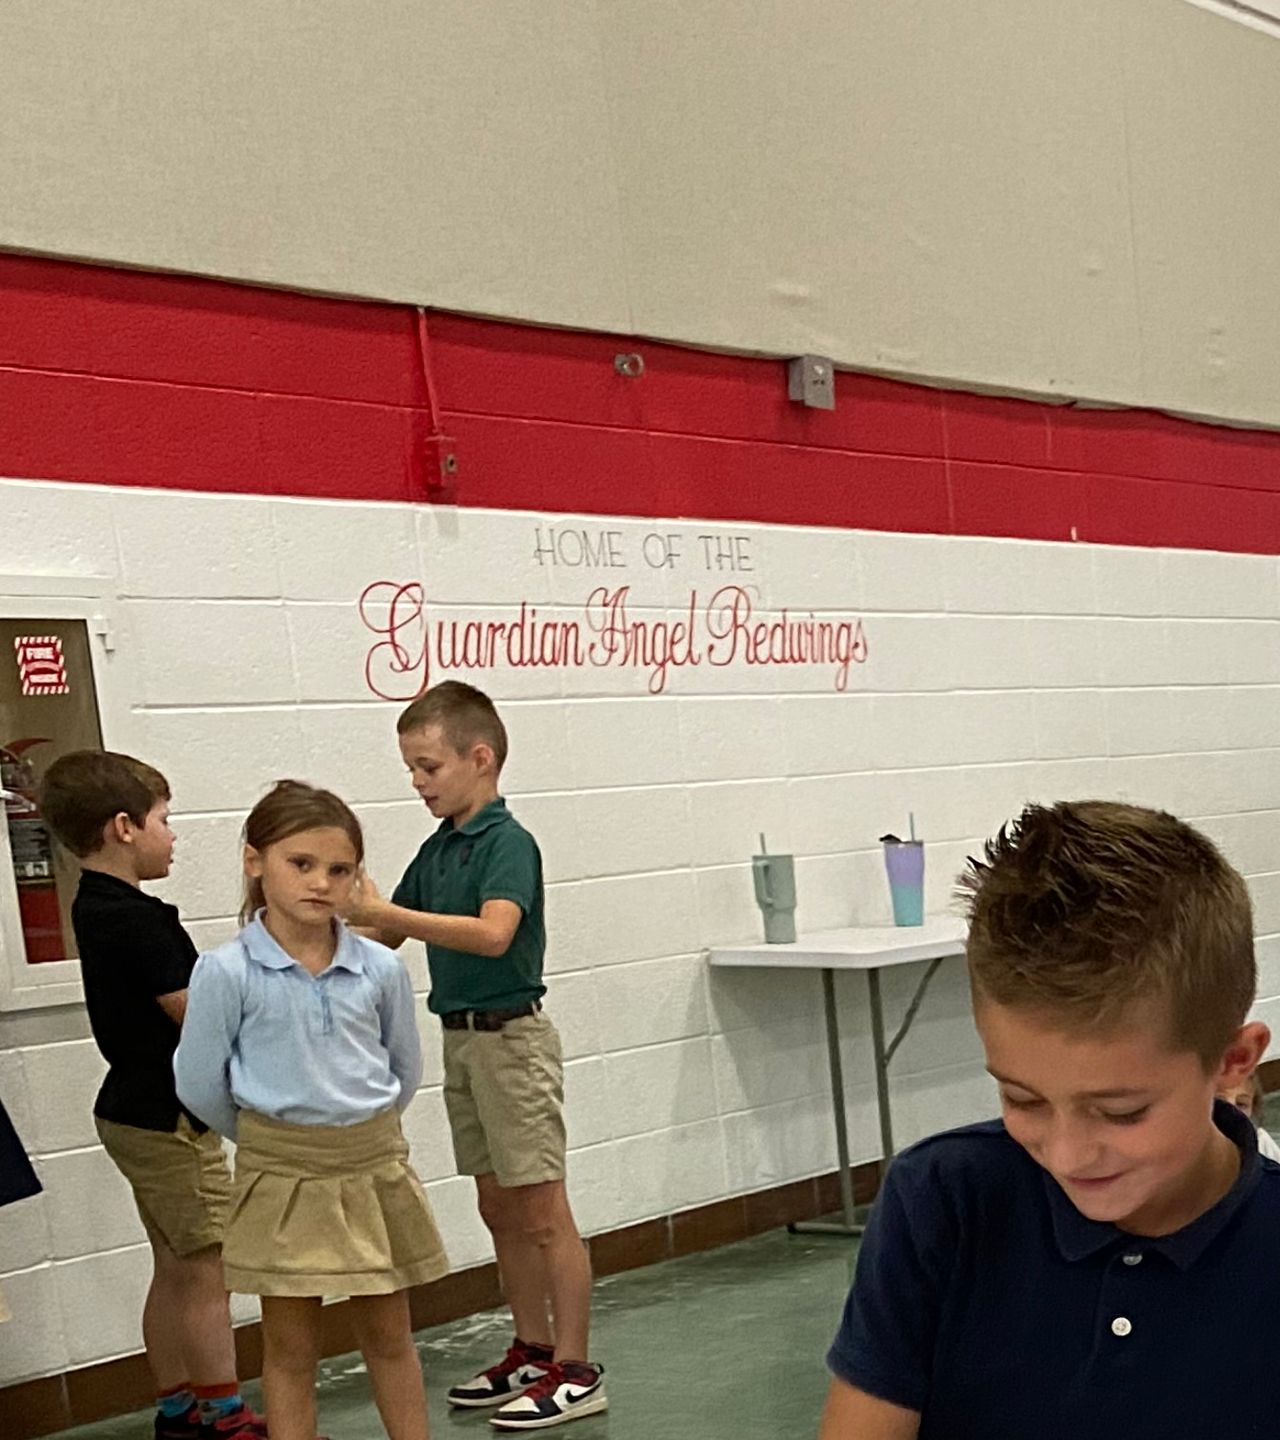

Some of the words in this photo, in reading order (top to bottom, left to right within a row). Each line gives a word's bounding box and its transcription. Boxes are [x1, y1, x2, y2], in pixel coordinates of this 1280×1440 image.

[534, 528, 627, 568] HOME
[642, 533, 681, 569] OF
[698, 535, 755, 572] THE
[359, 581, 584, 701] Guardian
[585, 585, 701, 694] Angel
[706, 584, 868, 692] Redwings
